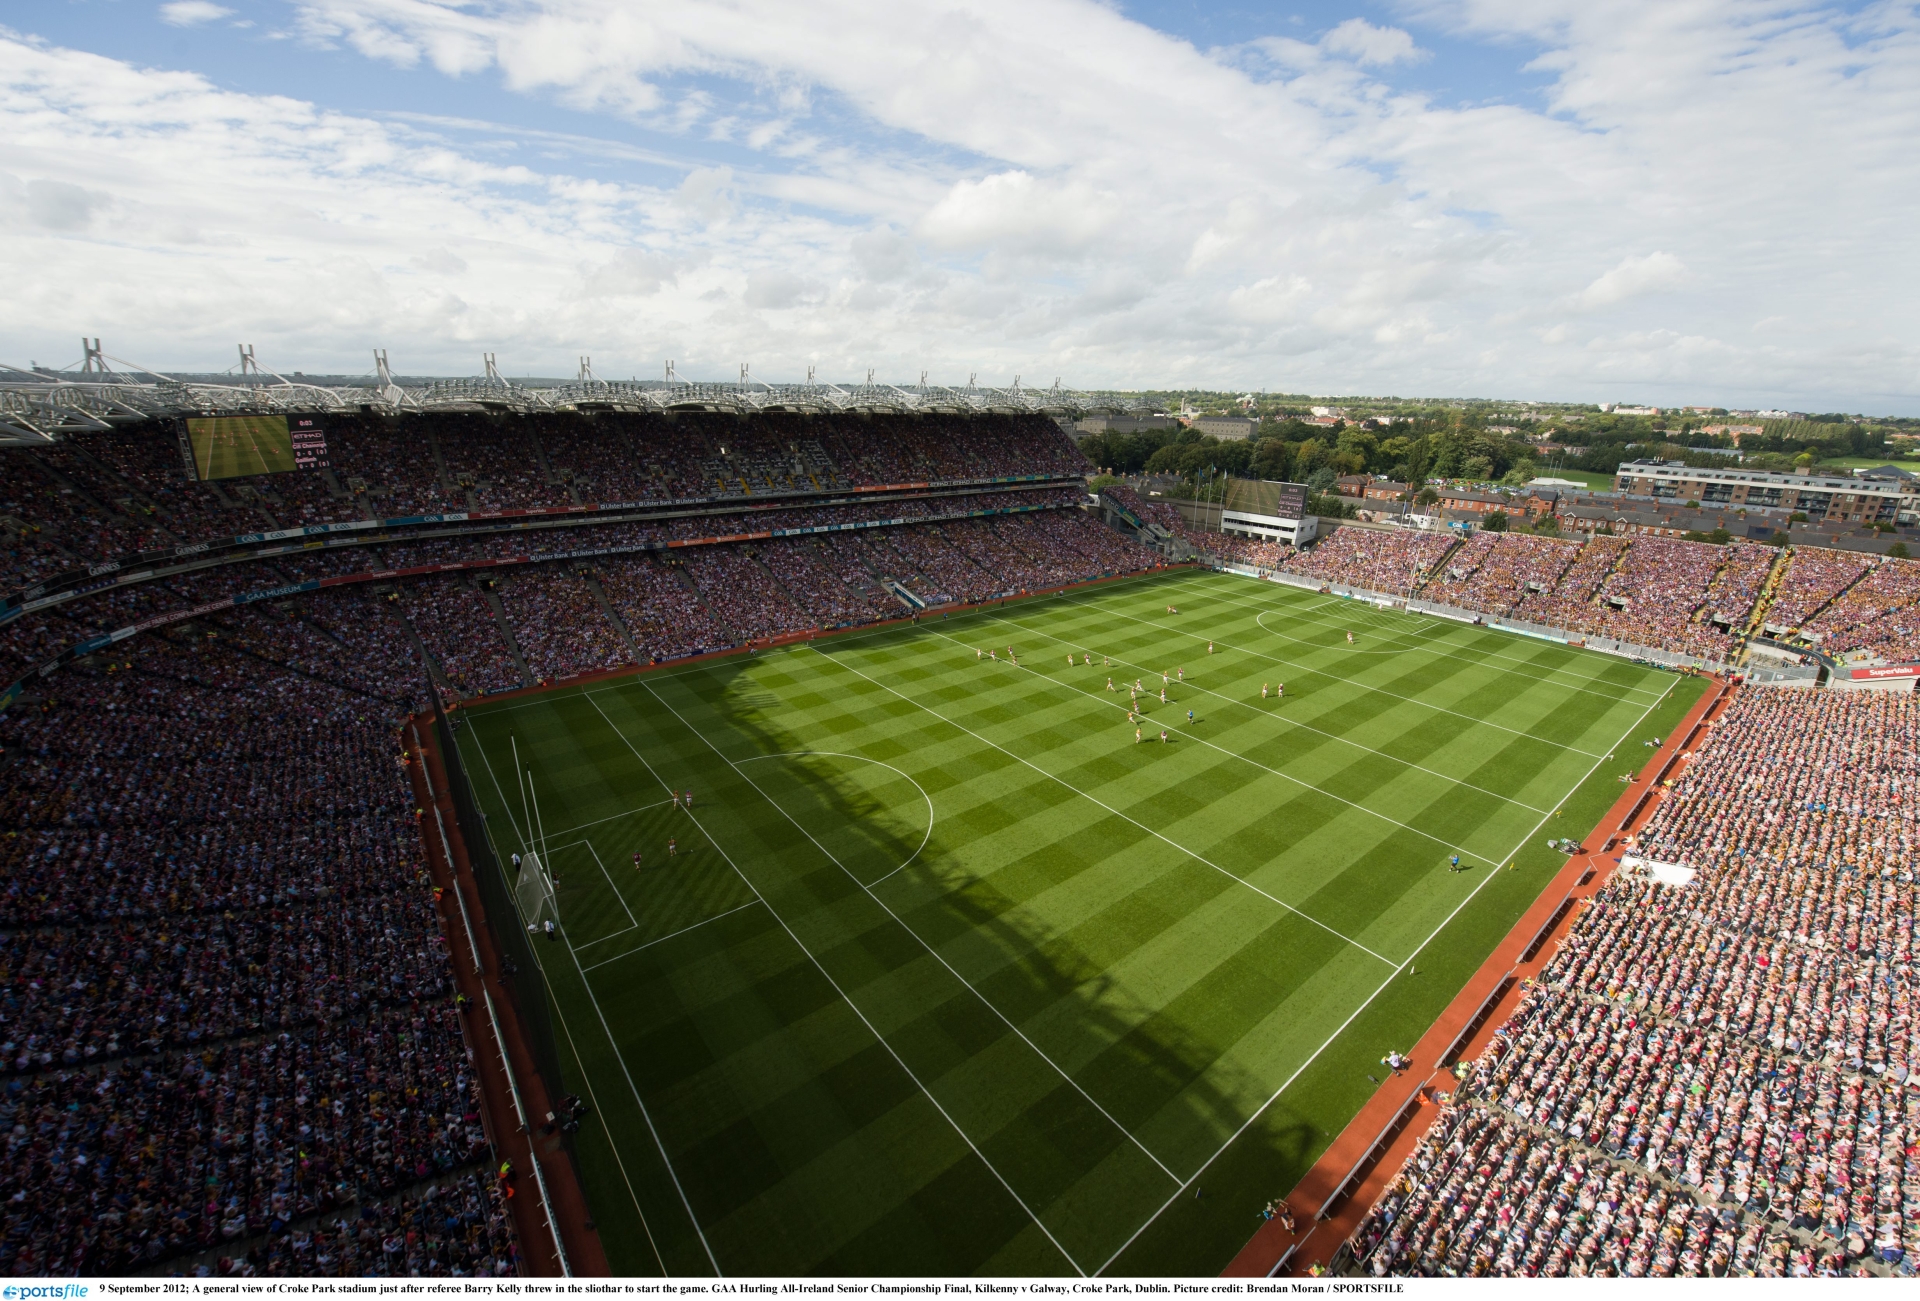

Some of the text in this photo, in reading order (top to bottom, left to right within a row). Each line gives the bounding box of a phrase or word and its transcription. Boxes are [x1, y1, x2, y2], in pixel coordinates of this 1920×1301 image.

[270, 531, 287, 539] GAA
[308, 525, 326, 534] GAA
[241, 533, 260, 543] GAA
[175, 543, 209, 555] GUINNESS
[88, 562, 121, 576] GUINNESS
[246, 585, 301, 600] GAA MUSEUM
[151, 616, 169, 626] PARK
[211, 598, 234, 609] CENTRE
[1869, 667, 1914, 676] SuperValu
